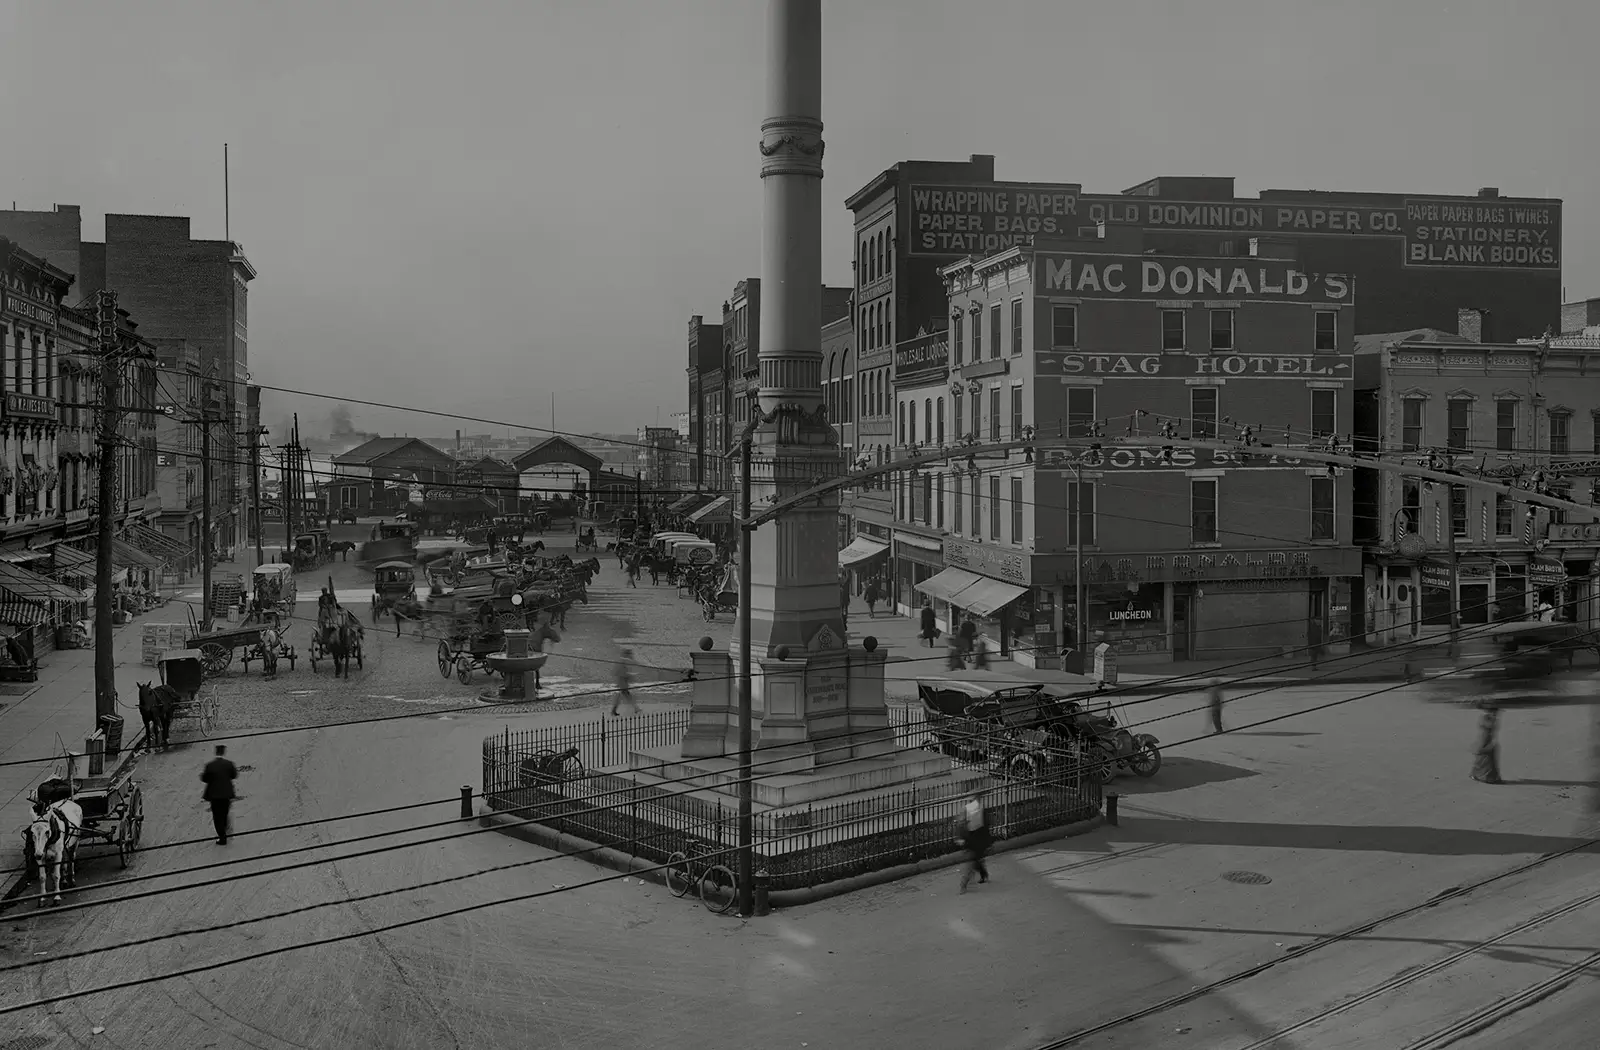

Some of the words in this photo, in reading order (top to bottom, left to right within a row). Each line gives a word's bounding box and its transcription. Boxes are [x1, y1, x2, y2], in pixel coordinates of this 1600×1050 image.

[914, 190, 1009, 213] WRAPPING
[1016, 192, 1077, 216] PAPER
[919, 213, 983, 231] PAPER
[995, 215, 1064, 233] BAGS,
[1089, 203, 1139, 222] OLD
[1149, 204, 1262, 226] DOMINION
[1278, 208, 1361, 230] PAPER
[1370, 212, 1402, 231] CO.
[1408, 204, 1438, 221] PAPER
[1442, 205, 1473, 222] PAPER
[1476, 207, 1504, 223] BAGS
[1416, 226, 1548, 245] STATIONERY,
[1411, 243, 1485, 262] BLANK
[1491, 246, 1558, 264] BOOKS.
[1046, 258, 1126, 292] MAC
[1141, 260, 1348, 299] DONALD'S
[8, 297, 35, 318] WHOLESALE
[36, 308, 54, 325] LIQUORS
[896, 346, 925, 366] WHOLESALE
[926, 341, 949, 360] LIQUORS
[1062, 355, 1162, 374] STAG
[1195, 356, 1334, 375] HOTEL.
[1041, 448, 1196, 468] ROOMS
[1530, 562, 1544, 571] CLAM
[1109, 609, 1152, 621] LUNCHEON
